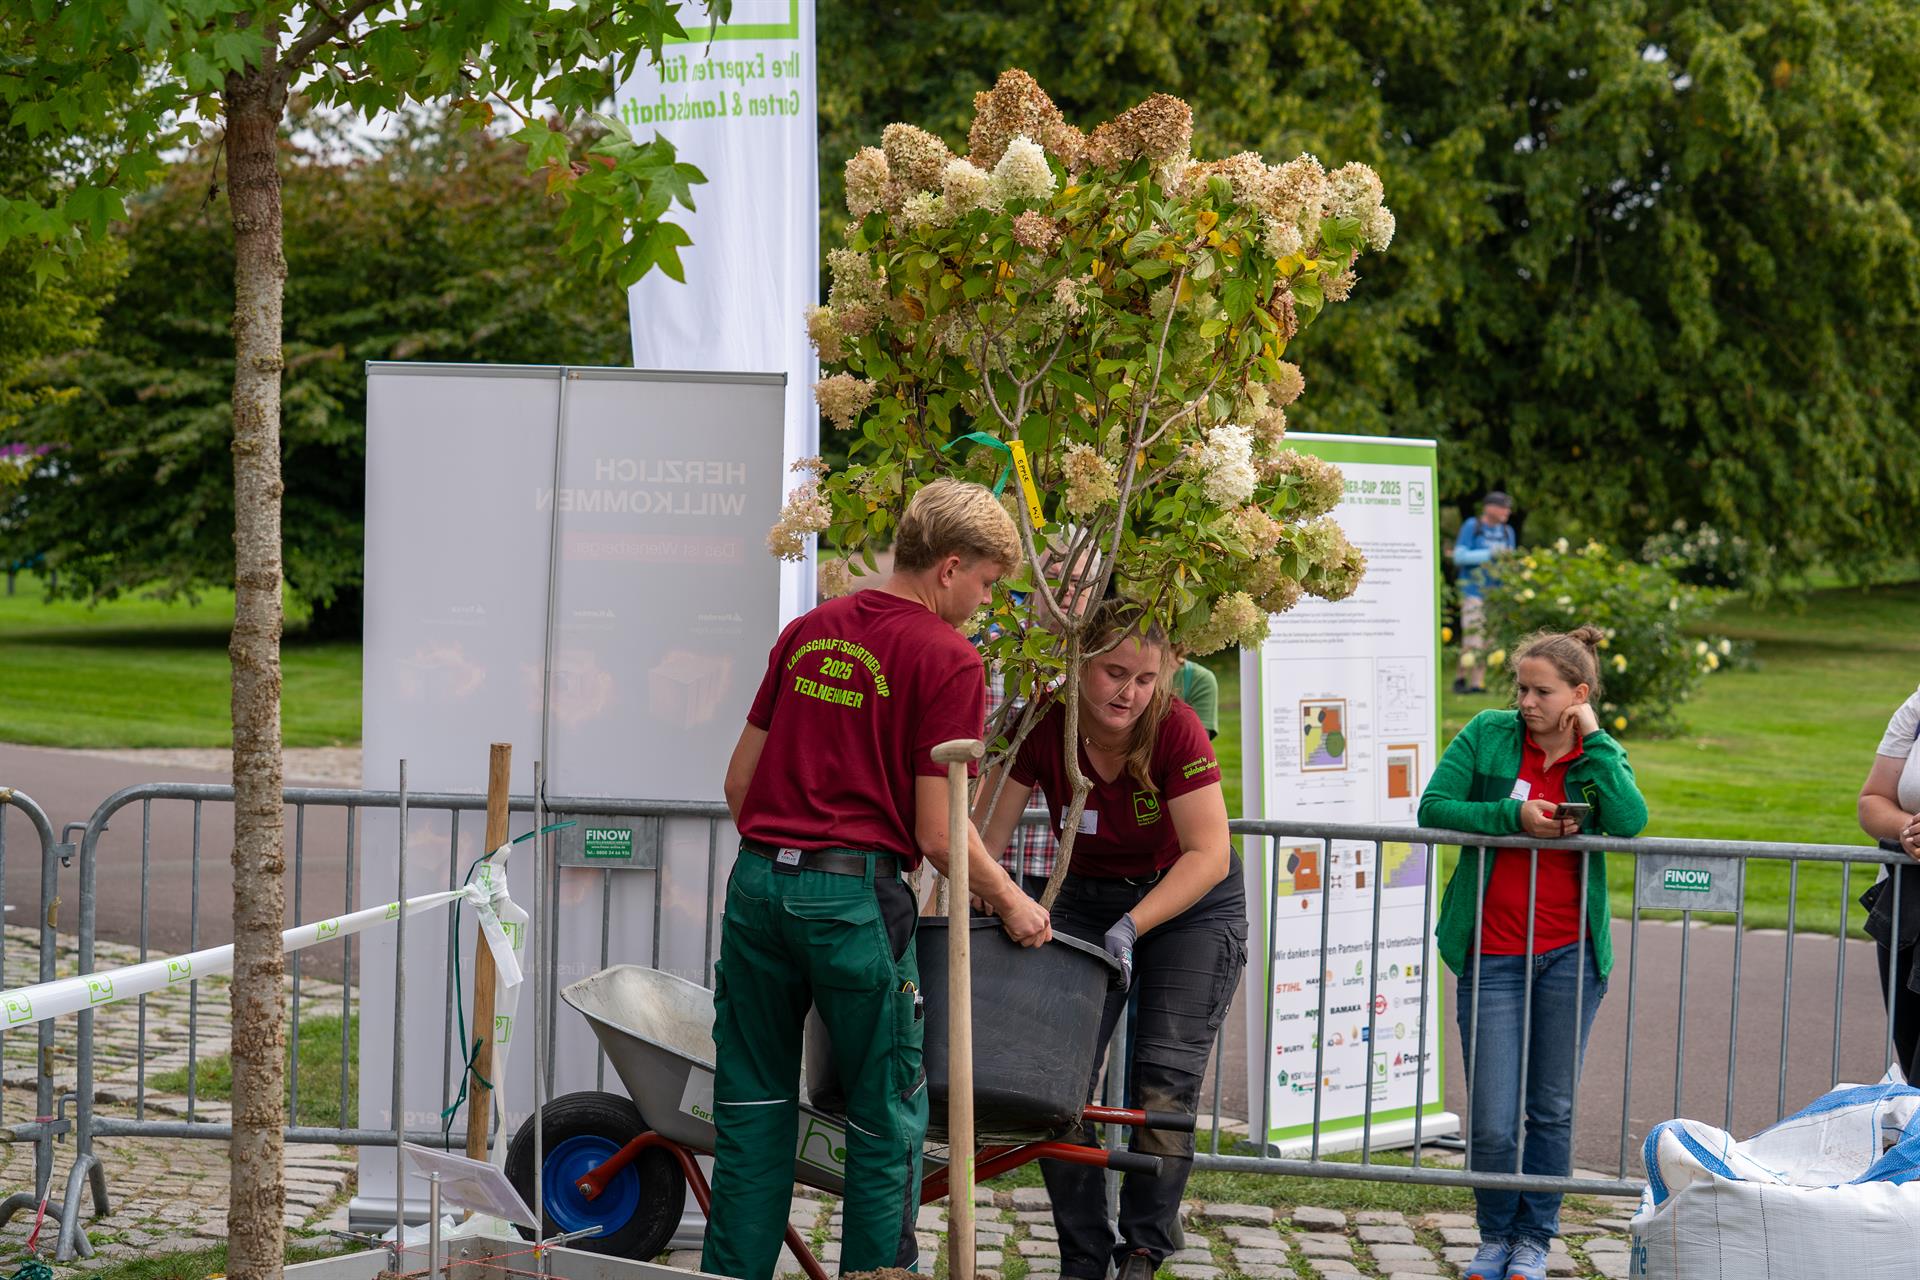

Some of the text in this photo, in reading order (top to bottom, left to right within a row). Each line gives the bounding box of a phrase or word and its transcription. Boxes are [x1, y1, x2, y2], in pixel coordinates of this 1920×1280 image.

[1380, 480, 1402, 495] 2025
[819, 657, 854, 680] 2025
[794, 676, 864, 708] TEILNEHMER
[585, 829, 631, 841] FINOW
[1664, 870, 1710, 884] FINOW
[1287, 947, 1310, 959] danken
[1275, 982, 1302, 993] STIHL
[1330, 1003, 1362, 1015] BAMAKA
